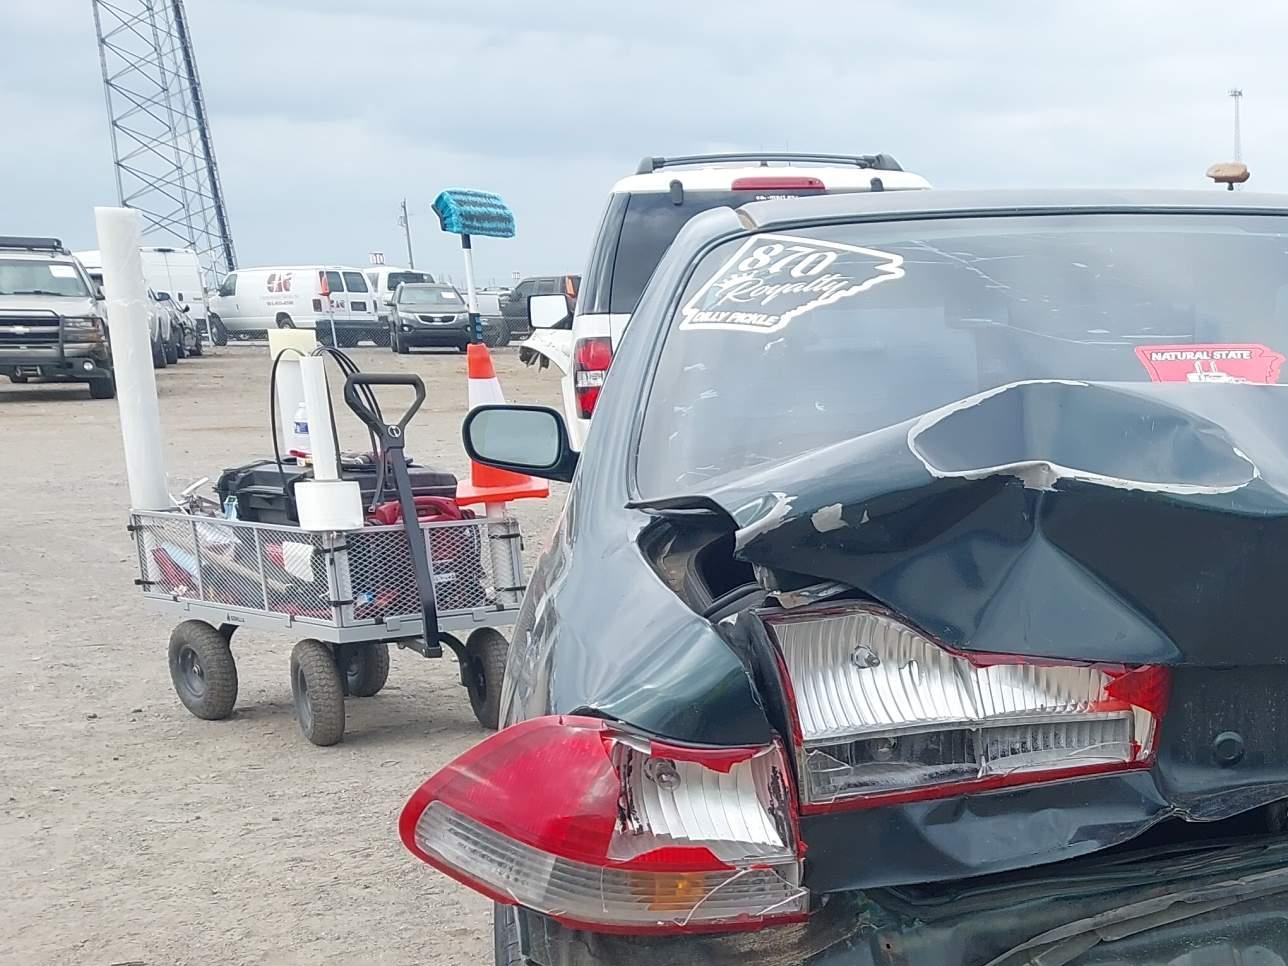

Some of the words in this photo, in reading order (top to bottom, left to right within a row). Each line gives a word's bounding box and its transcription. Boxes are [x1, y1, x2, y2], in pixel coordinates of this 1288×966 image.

[738, 243, 837, 278] 870
[713, 274, 852, 310] Royalty
[1151, 351, 1211, 361] NATURAL
[1212, 350, 1251, 360] STATE
